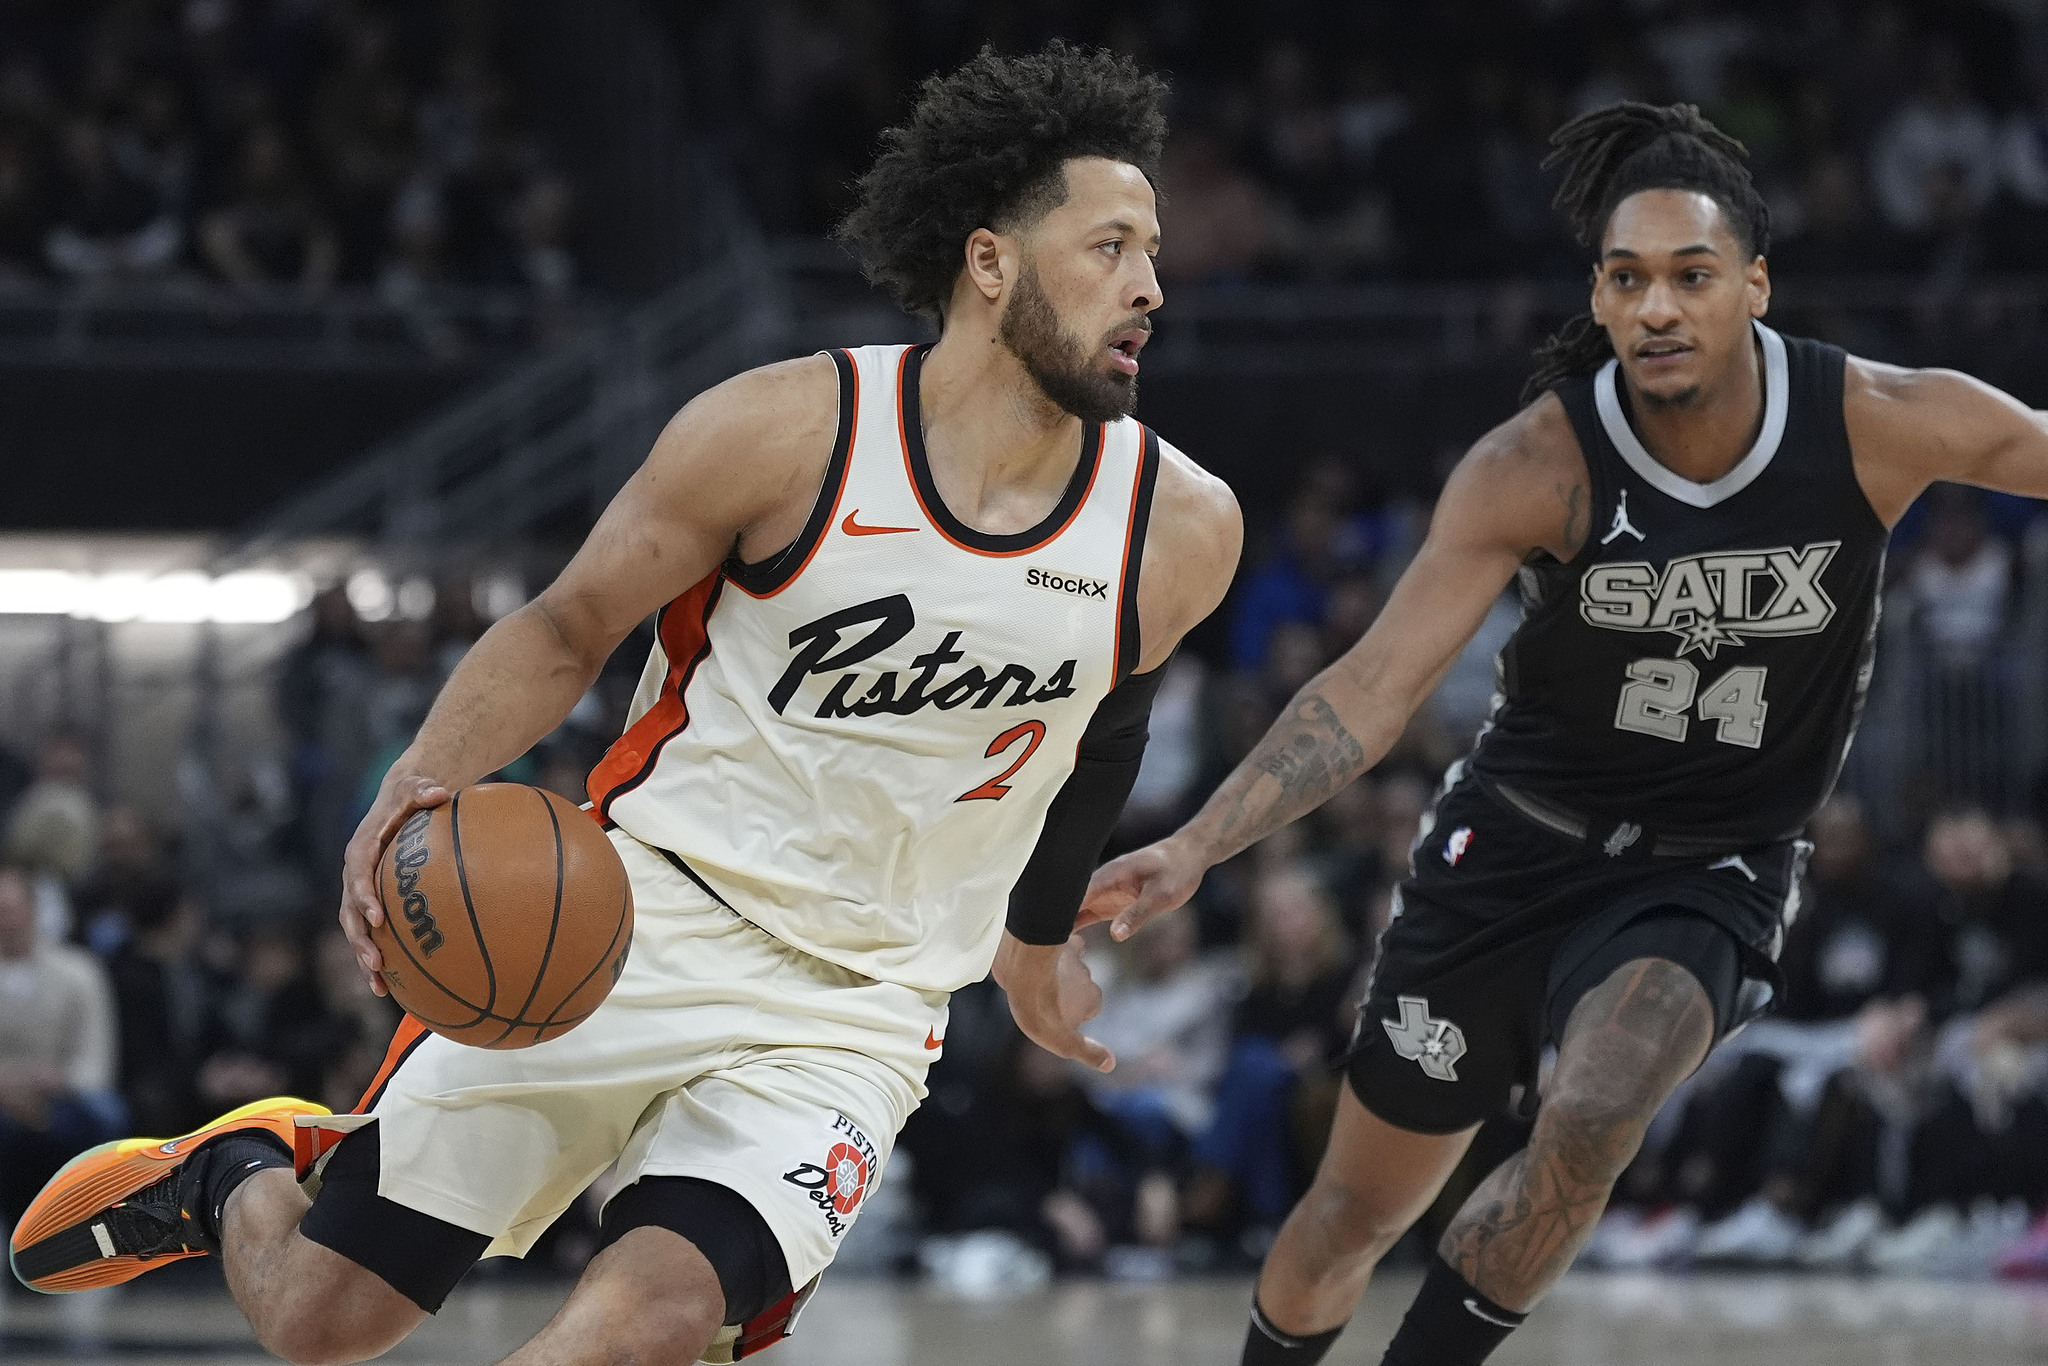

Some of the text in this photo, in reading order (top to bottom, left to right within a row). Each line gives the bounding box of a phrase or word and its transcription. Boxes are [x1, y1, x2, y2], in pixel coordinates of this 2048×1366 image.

[1026, 567, 1108, 600] StockX
[1580, 540, 1842, 638] SATX
[767, 593, 1077, 718] Pistons
[1614, 658, 1768, 749] 24
[953, 719, 1046, 803] 2
[782, 1162, 847, 1237] Detroit
